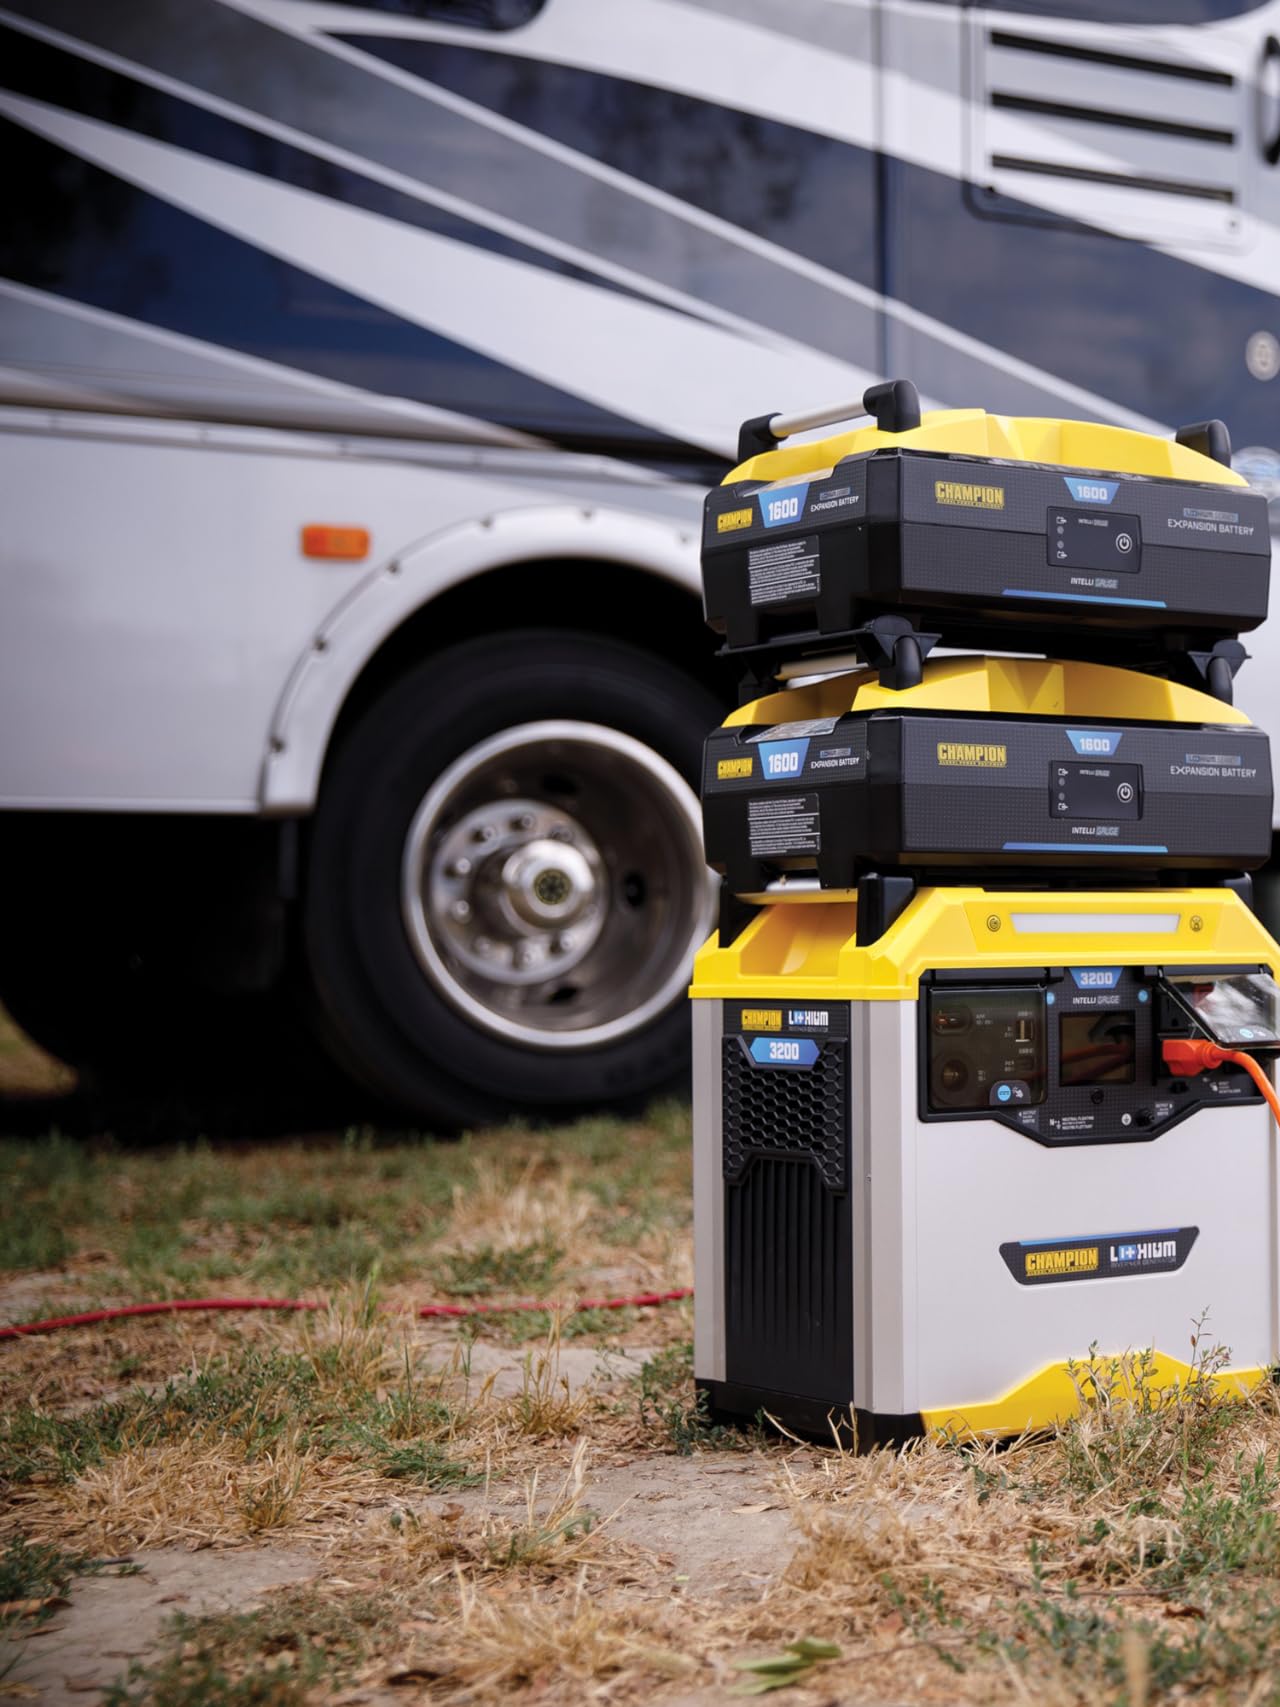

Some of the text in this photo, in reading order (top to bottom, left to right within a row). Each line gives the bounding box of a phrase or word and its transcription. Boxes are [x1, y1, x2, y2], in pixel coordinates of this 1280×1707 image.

[936, 482, 1004, 505] CHAMPION
[1077, 485, 1108, 500] 1600
[768, 497, 799, 521] 1600
[810, 496, 860, 513] EXPANSION BATTERY
[718, 509, 752, 531] CHAMPION
[1167, 519, 1254, 536] EXPANSION BATTERY
[939, 743, 1006, 762] CHAMPION
[1079, 737, 1111, 752] 1600
[718, 758, 752, 777] CHAMPION
[768, 752, 799, 774] 1600
[810, 756, 860, 769] EXPANSION BATTERY
[1169, 765, 1257, 779] EXPANSION BATTERY
[1080, 971, 1113, 985] 3200
[743, 1011, 781, 1027] CHAMPION
[769, 1042, 800, 1060] 3200
[1026, 1248, 1099, 1271] CHAMPION
